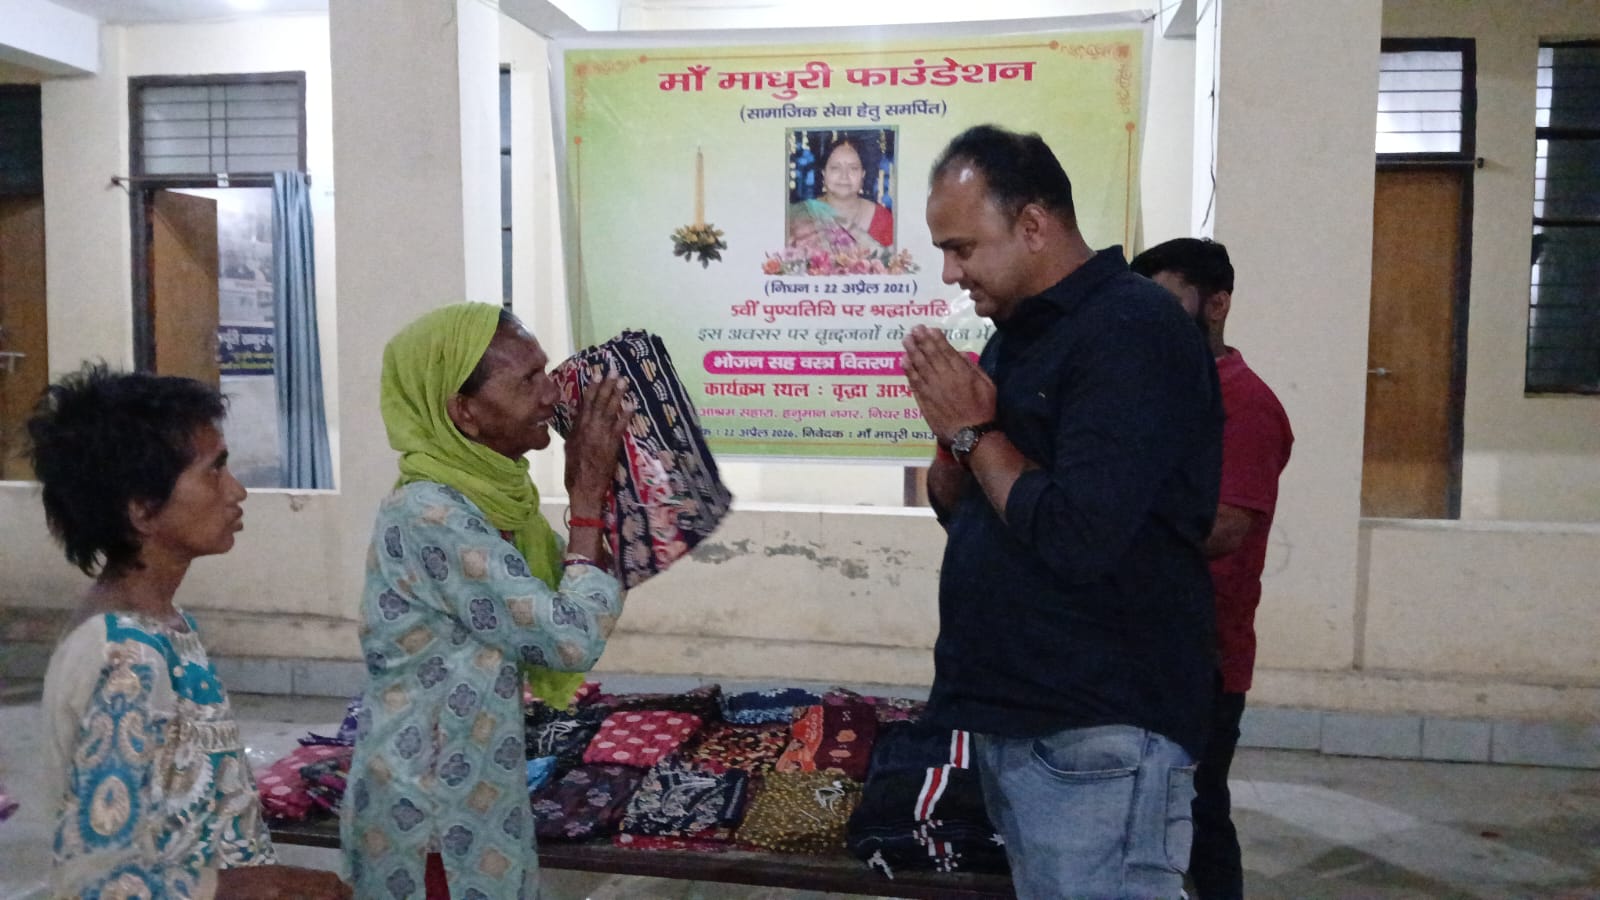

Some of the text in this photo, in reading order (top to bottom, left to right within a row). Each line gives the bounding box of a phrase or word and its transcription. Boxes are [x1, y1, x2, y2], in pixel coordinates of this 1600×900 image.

[659, 57, 1036, 101] माँ माधुरी फाउंडेशन
[740, 99, 947, 122] (सामाजिक सेवा हेतु समर्पित)
[764, 280, 809, 296] (निधन
[824, 284, 838, 294] 22
[842, 281, 879, 296] अप्रैल
[884, 280, 918, 296] 2021)
[763, 300, 836, 323] पुण्यतिथि
[842, 304, 866, 318] पर
[698, 328, 722, 341] इस
[728, 328, 781, 341] अवसर
[787, 328, 809, 341] पर
[713, 352, 764, 369] भोजन
[768, 356, 797, 370] सह
[840, 352, 896, 370] वितरण
[772, 383, 809, 397] स्थल
[832, 384, 868, 402] वृद्धा
[802, 426, 844, 438] निवेदक
[874, 428, 908, 443] माधुरी
